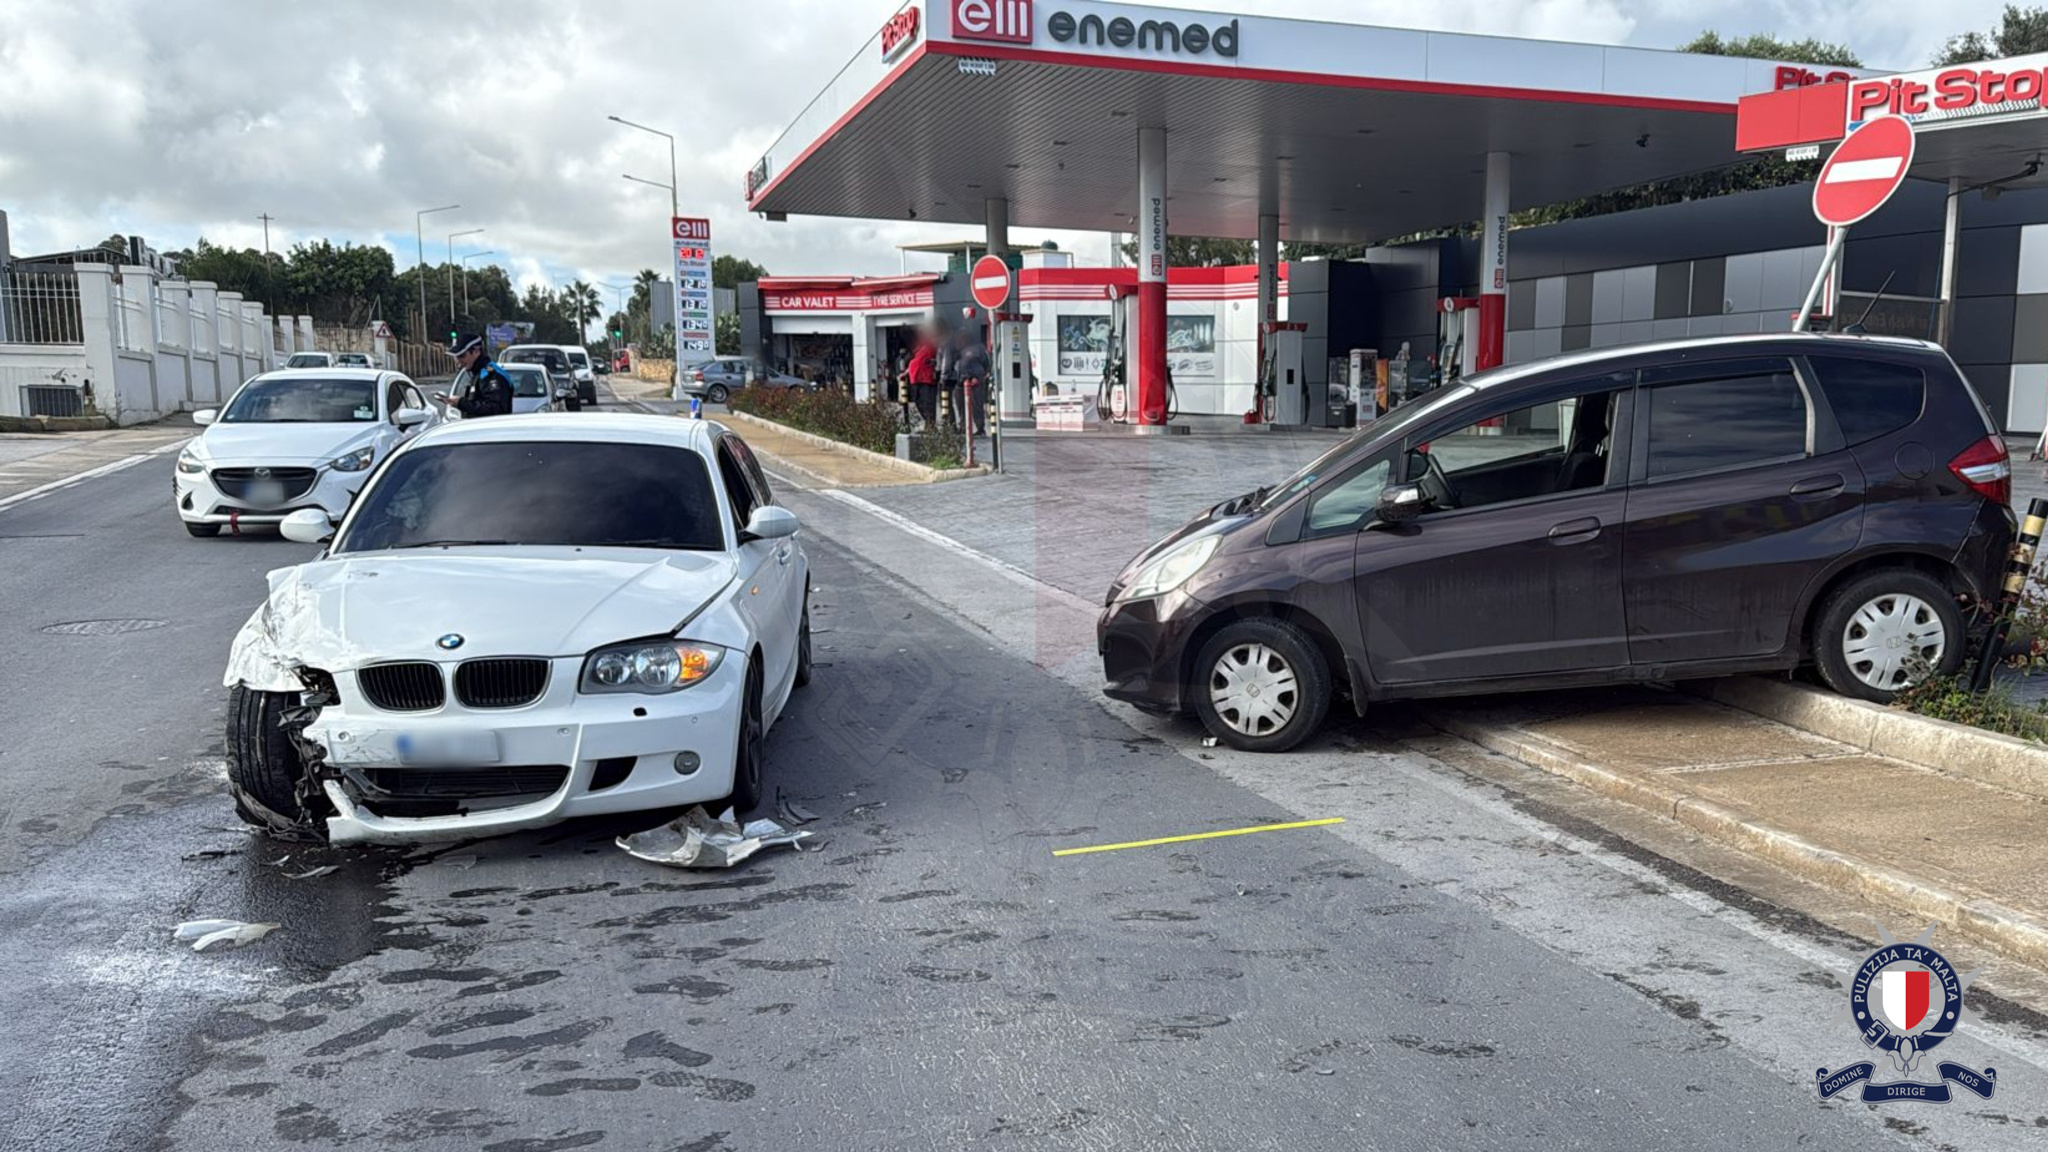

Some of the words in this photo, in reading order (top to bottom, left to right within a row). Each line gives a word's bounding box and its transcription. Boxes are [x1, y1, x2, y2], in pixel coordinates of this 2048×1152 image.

[1048, 11, 1239, 57] enemed
[1851, 78, 1928, 121] Pit
[1934, 67, 2048, 111] Sto
[1151, 198, 1161, 250] enemed
[1497, 216, 1505, 265] enemed
[782, 297, 802, 308] CAR
[802, 297, 835, 308] VALET
[873, 294, 888, 307] TYRE
[888, 293, 917, 305] SERVICE
